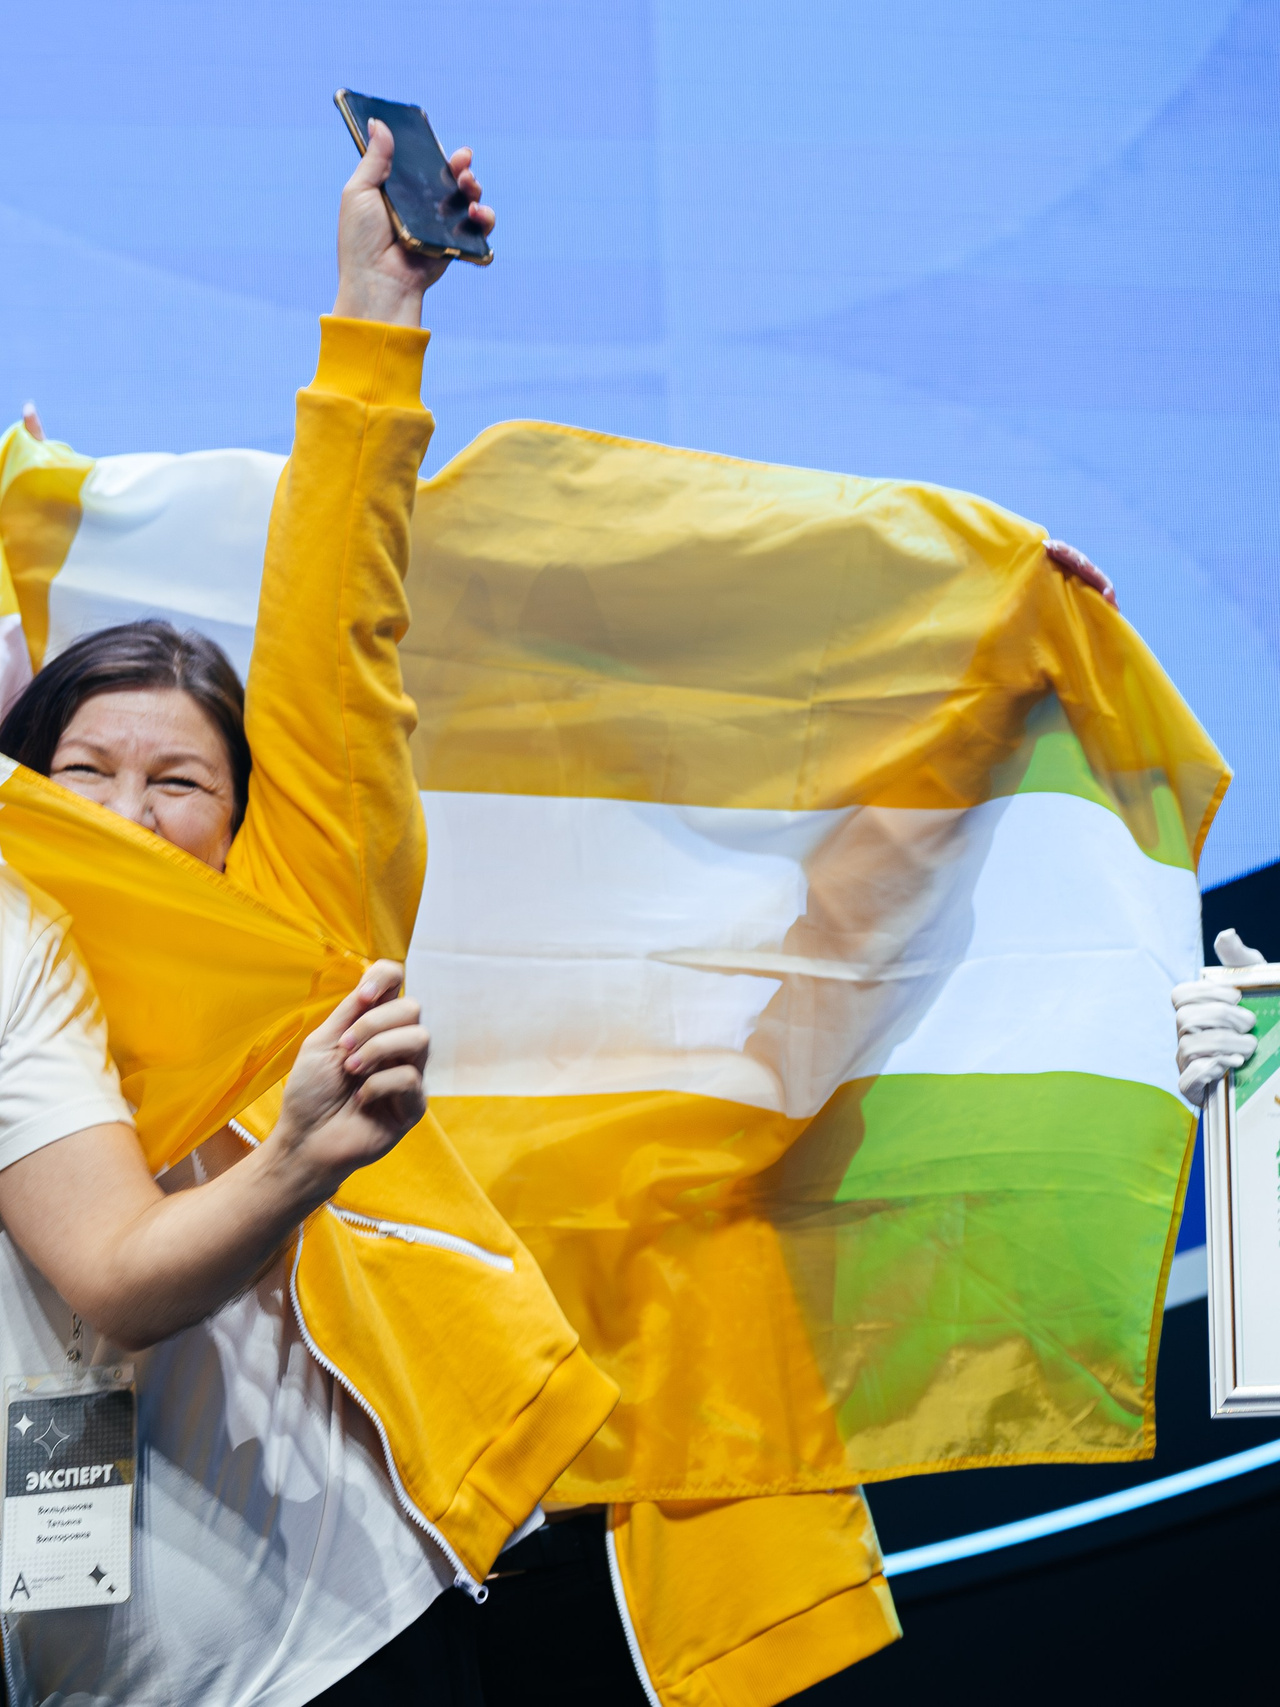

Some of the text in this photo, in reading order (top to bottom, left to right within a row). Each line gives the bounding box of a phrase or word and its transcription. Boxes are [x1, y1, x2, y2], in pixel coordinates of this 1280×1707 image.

[25, 1463, 114, 1492] ЭКСПЕРТ
[47, 1518, 82, 1528] Татьяна
[36, 1531, 91, 1544] Викторовна
